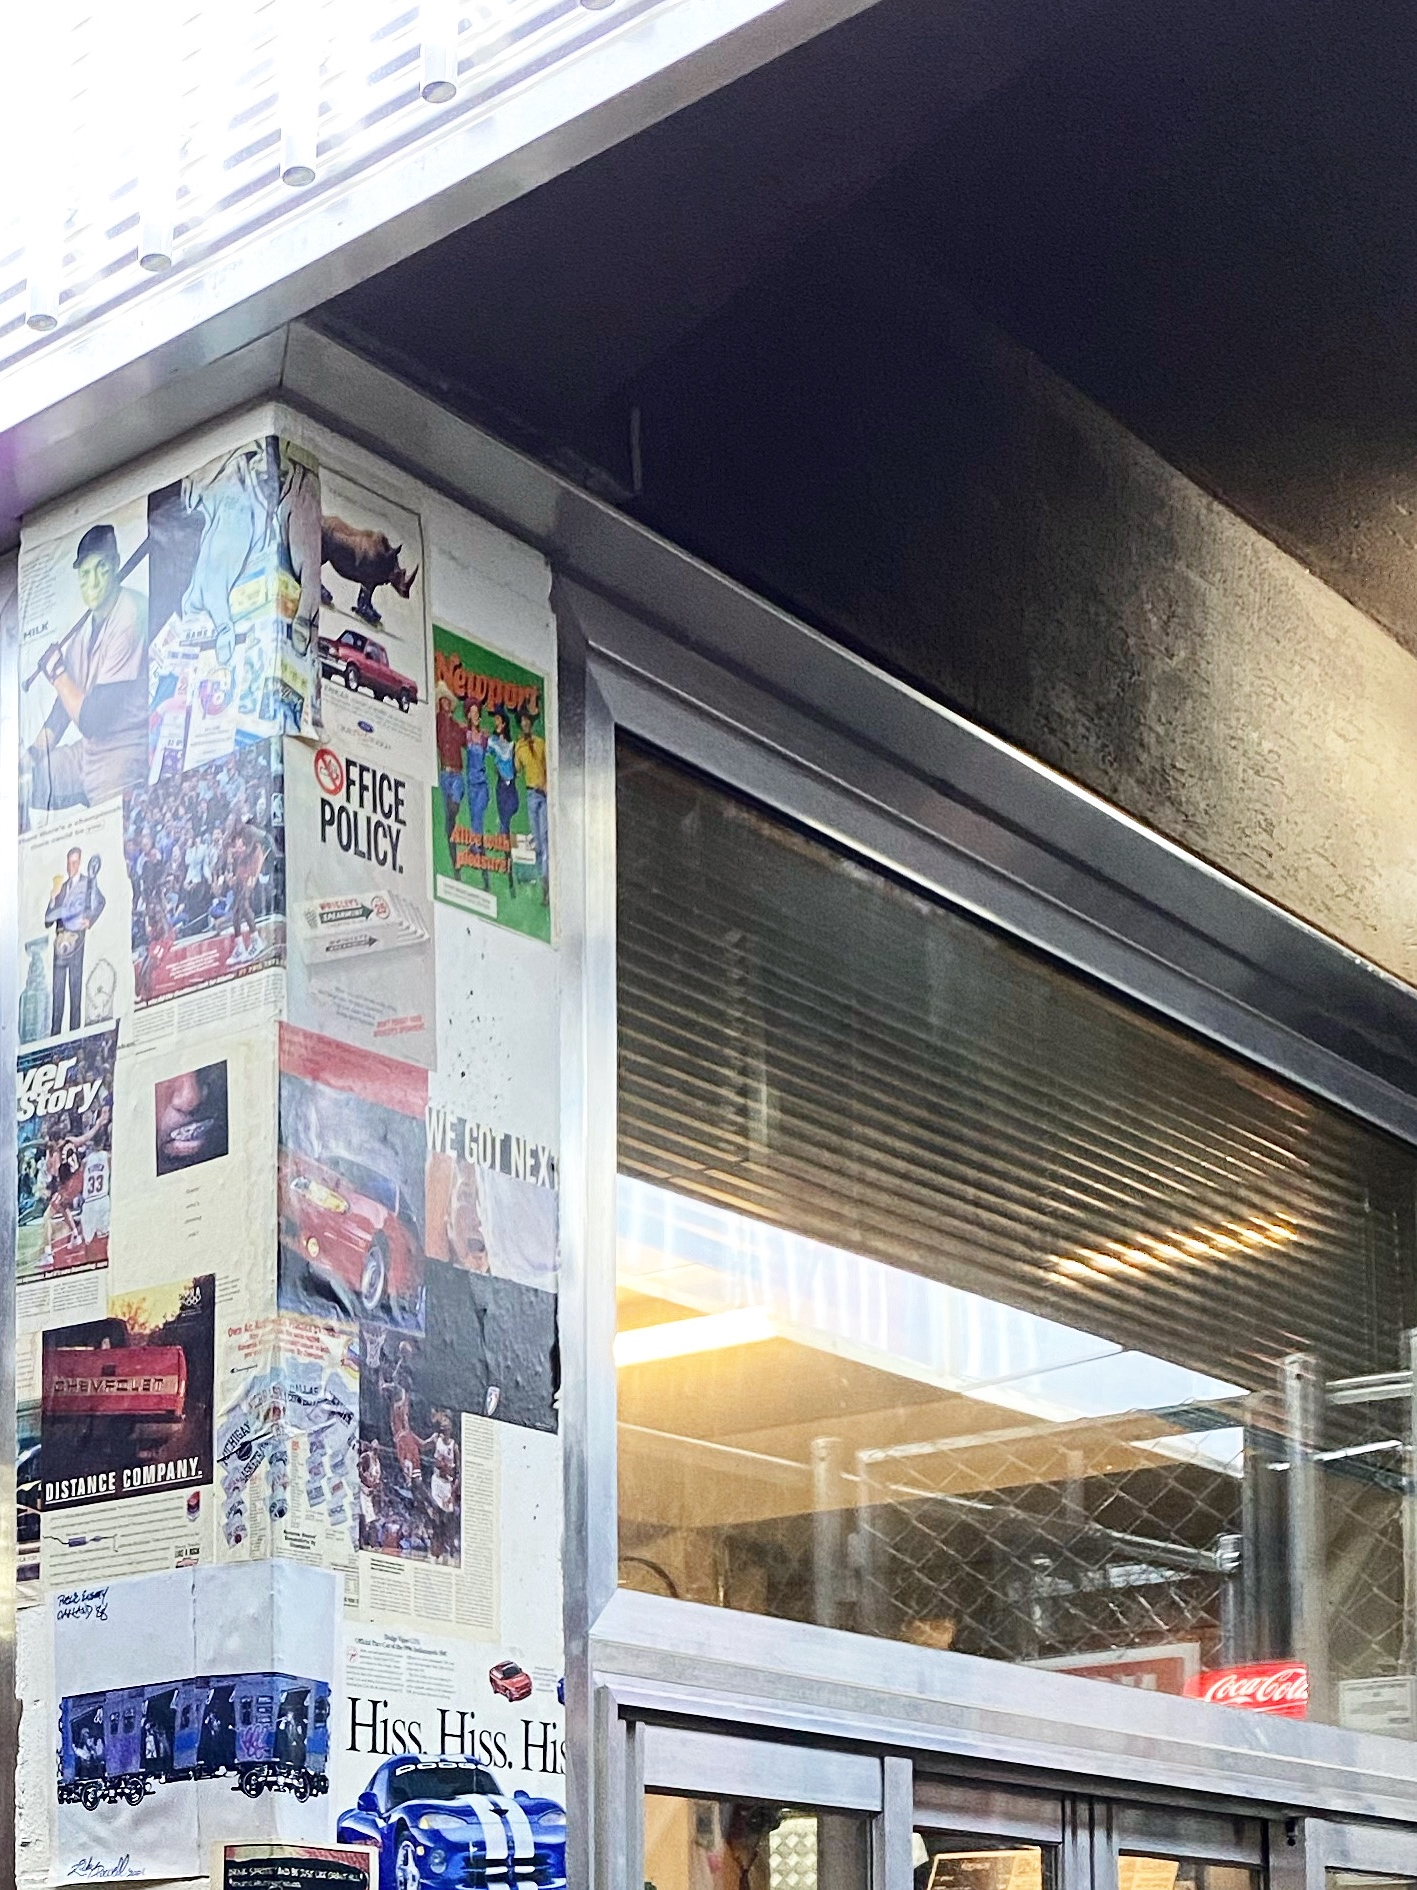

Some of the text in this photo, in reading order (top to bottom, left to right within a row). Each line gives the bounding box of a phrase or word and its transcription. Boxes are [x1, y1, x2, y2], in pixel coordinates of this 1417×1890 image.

[434, 652, 539, 716] Newport
[320, 797, 404, 874] POLICY.
[17, 1079, 103, 1123] Story
[425, 1105, 459, 1160] WE
[465, 1119, 507, 1174] GOT
[87, 1174, 104, 1195] 33
[54, 1376, 165, 1394] CHEVROLET
[45, 1456, 203, 1503] DISTANCE COMPANY.
[346, 1697, 428, 1756] Hiss.
[437, 1708, 513, 1770] Hiss.
